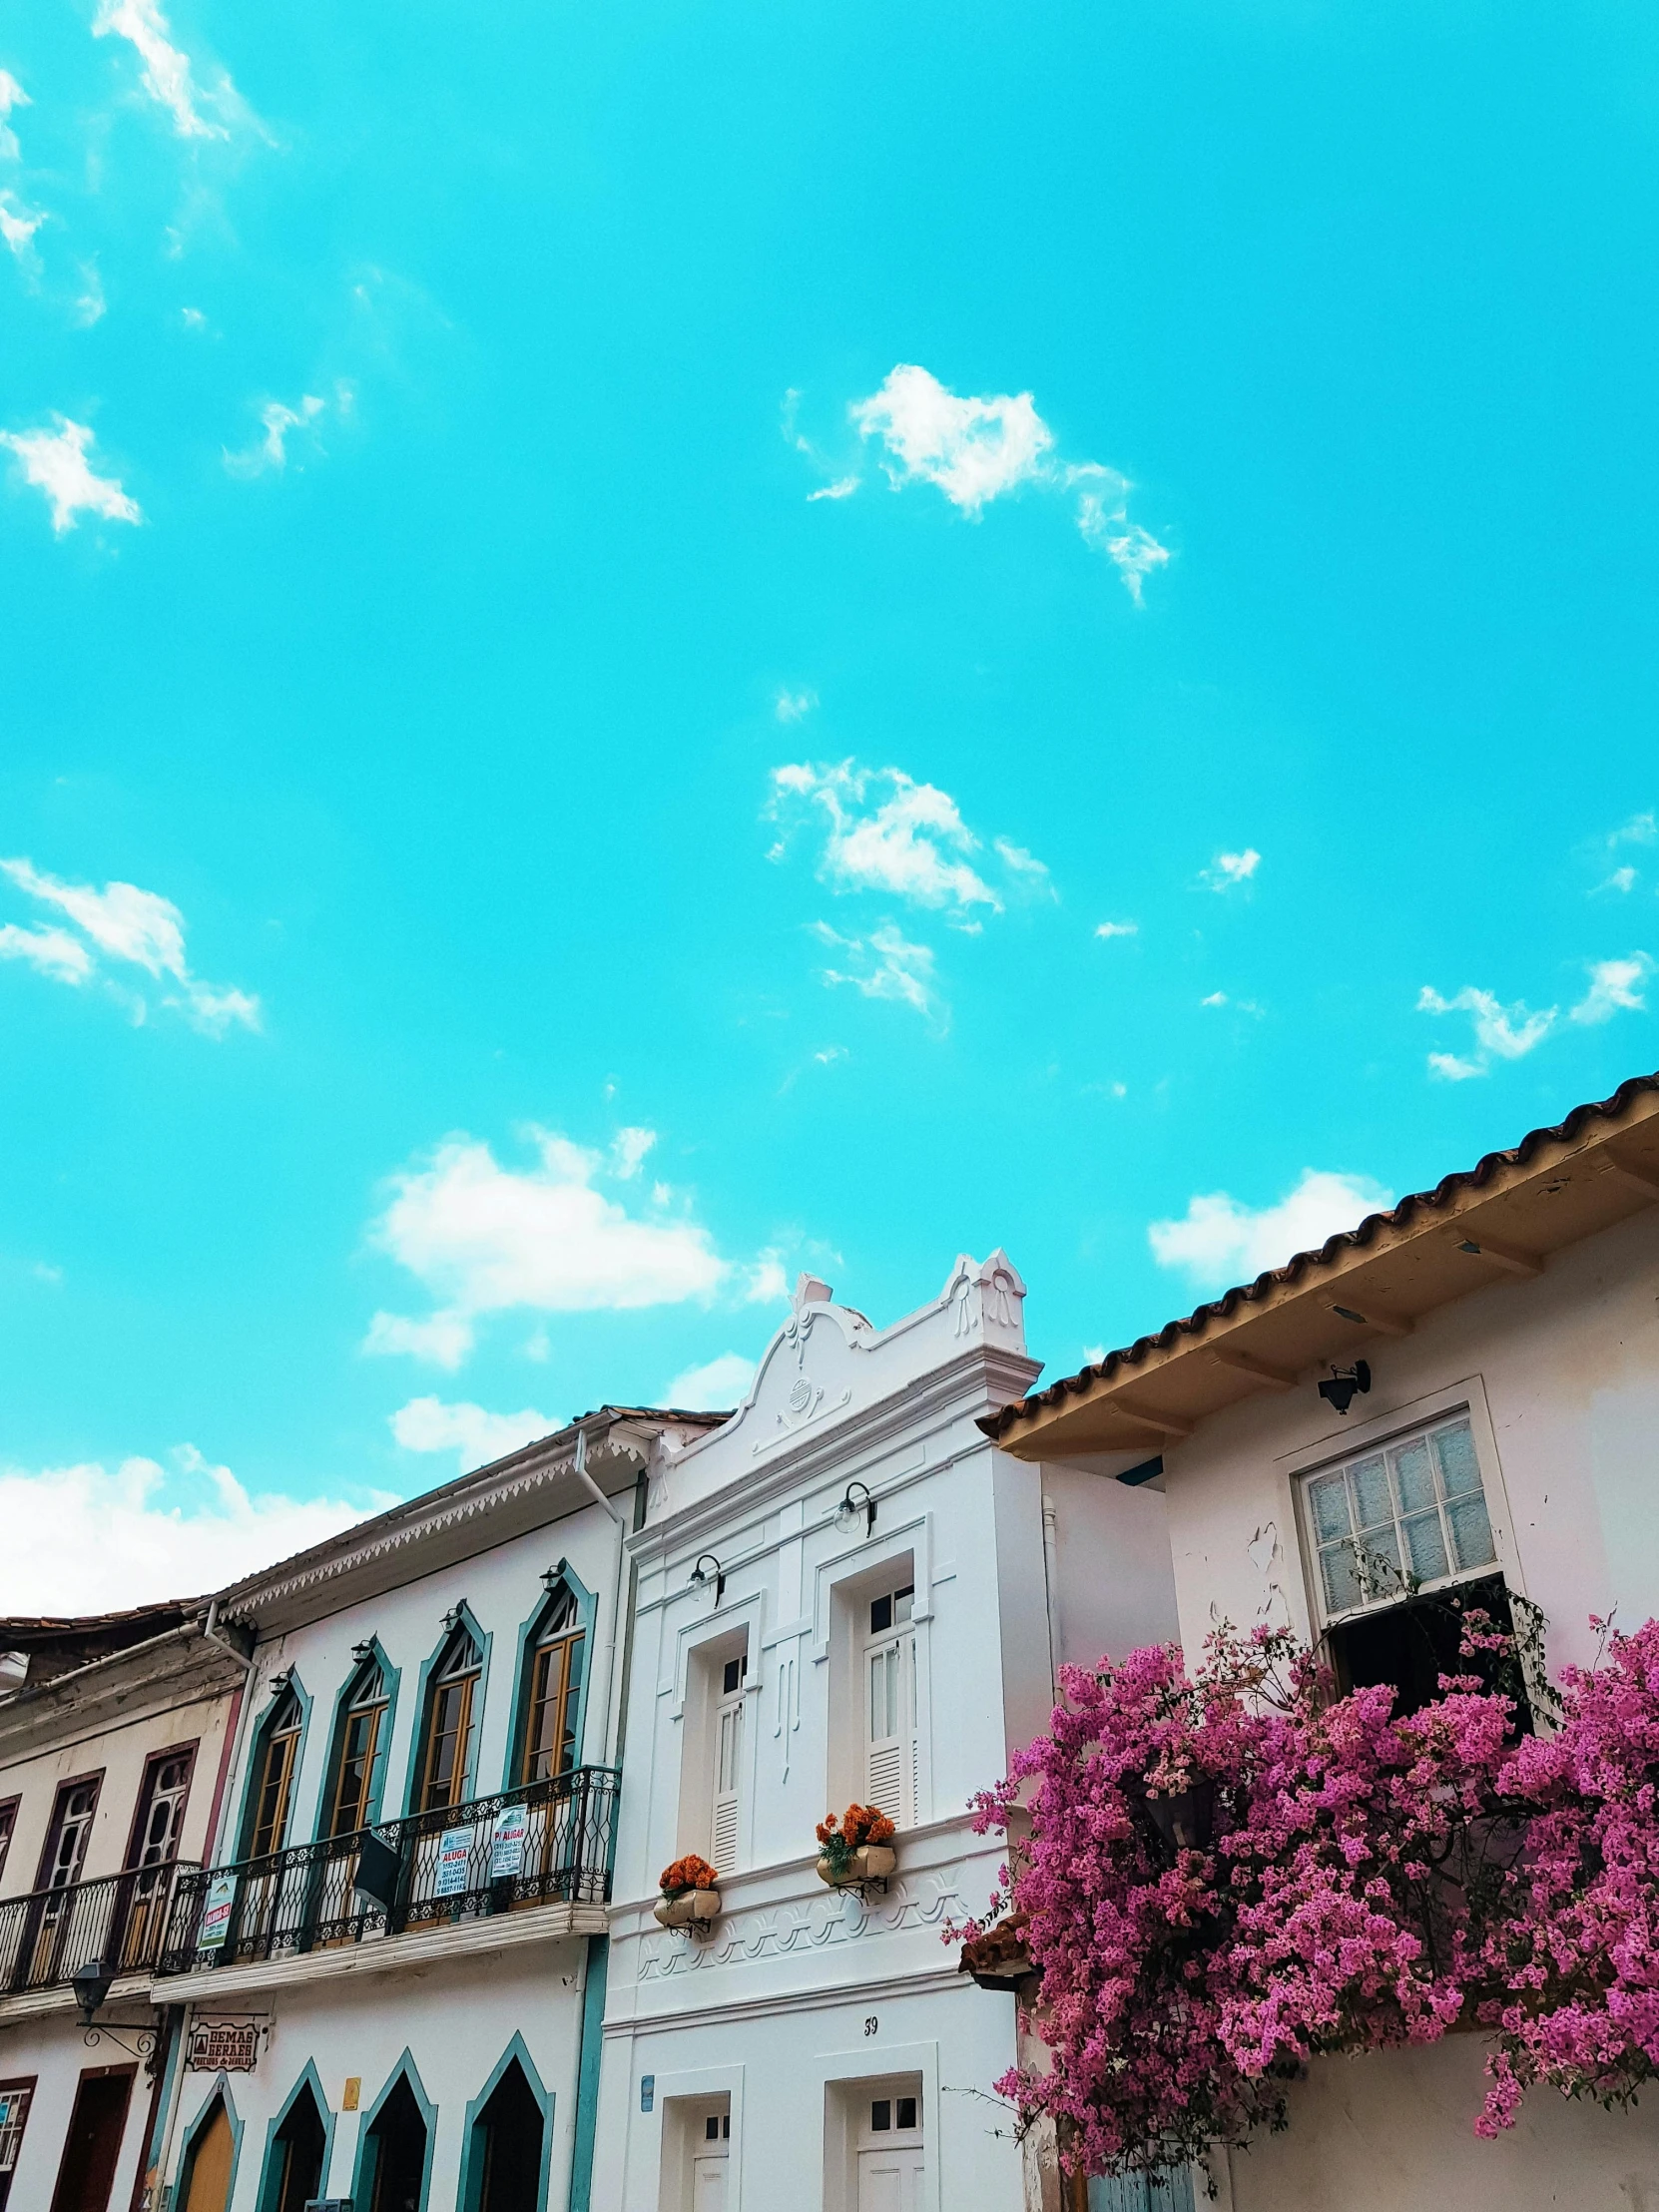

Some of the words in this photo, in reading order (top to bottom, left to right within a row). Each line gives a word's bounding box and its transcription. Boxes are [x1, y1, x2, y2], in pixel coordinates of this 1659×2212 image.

[503, 1829, 524, 1842] ALUGAR
[443, 1849, 466, 1864] ALUGA
[864, 2015, 878, 2036] 39
[208, 2043, 253, 2056] GERAES
